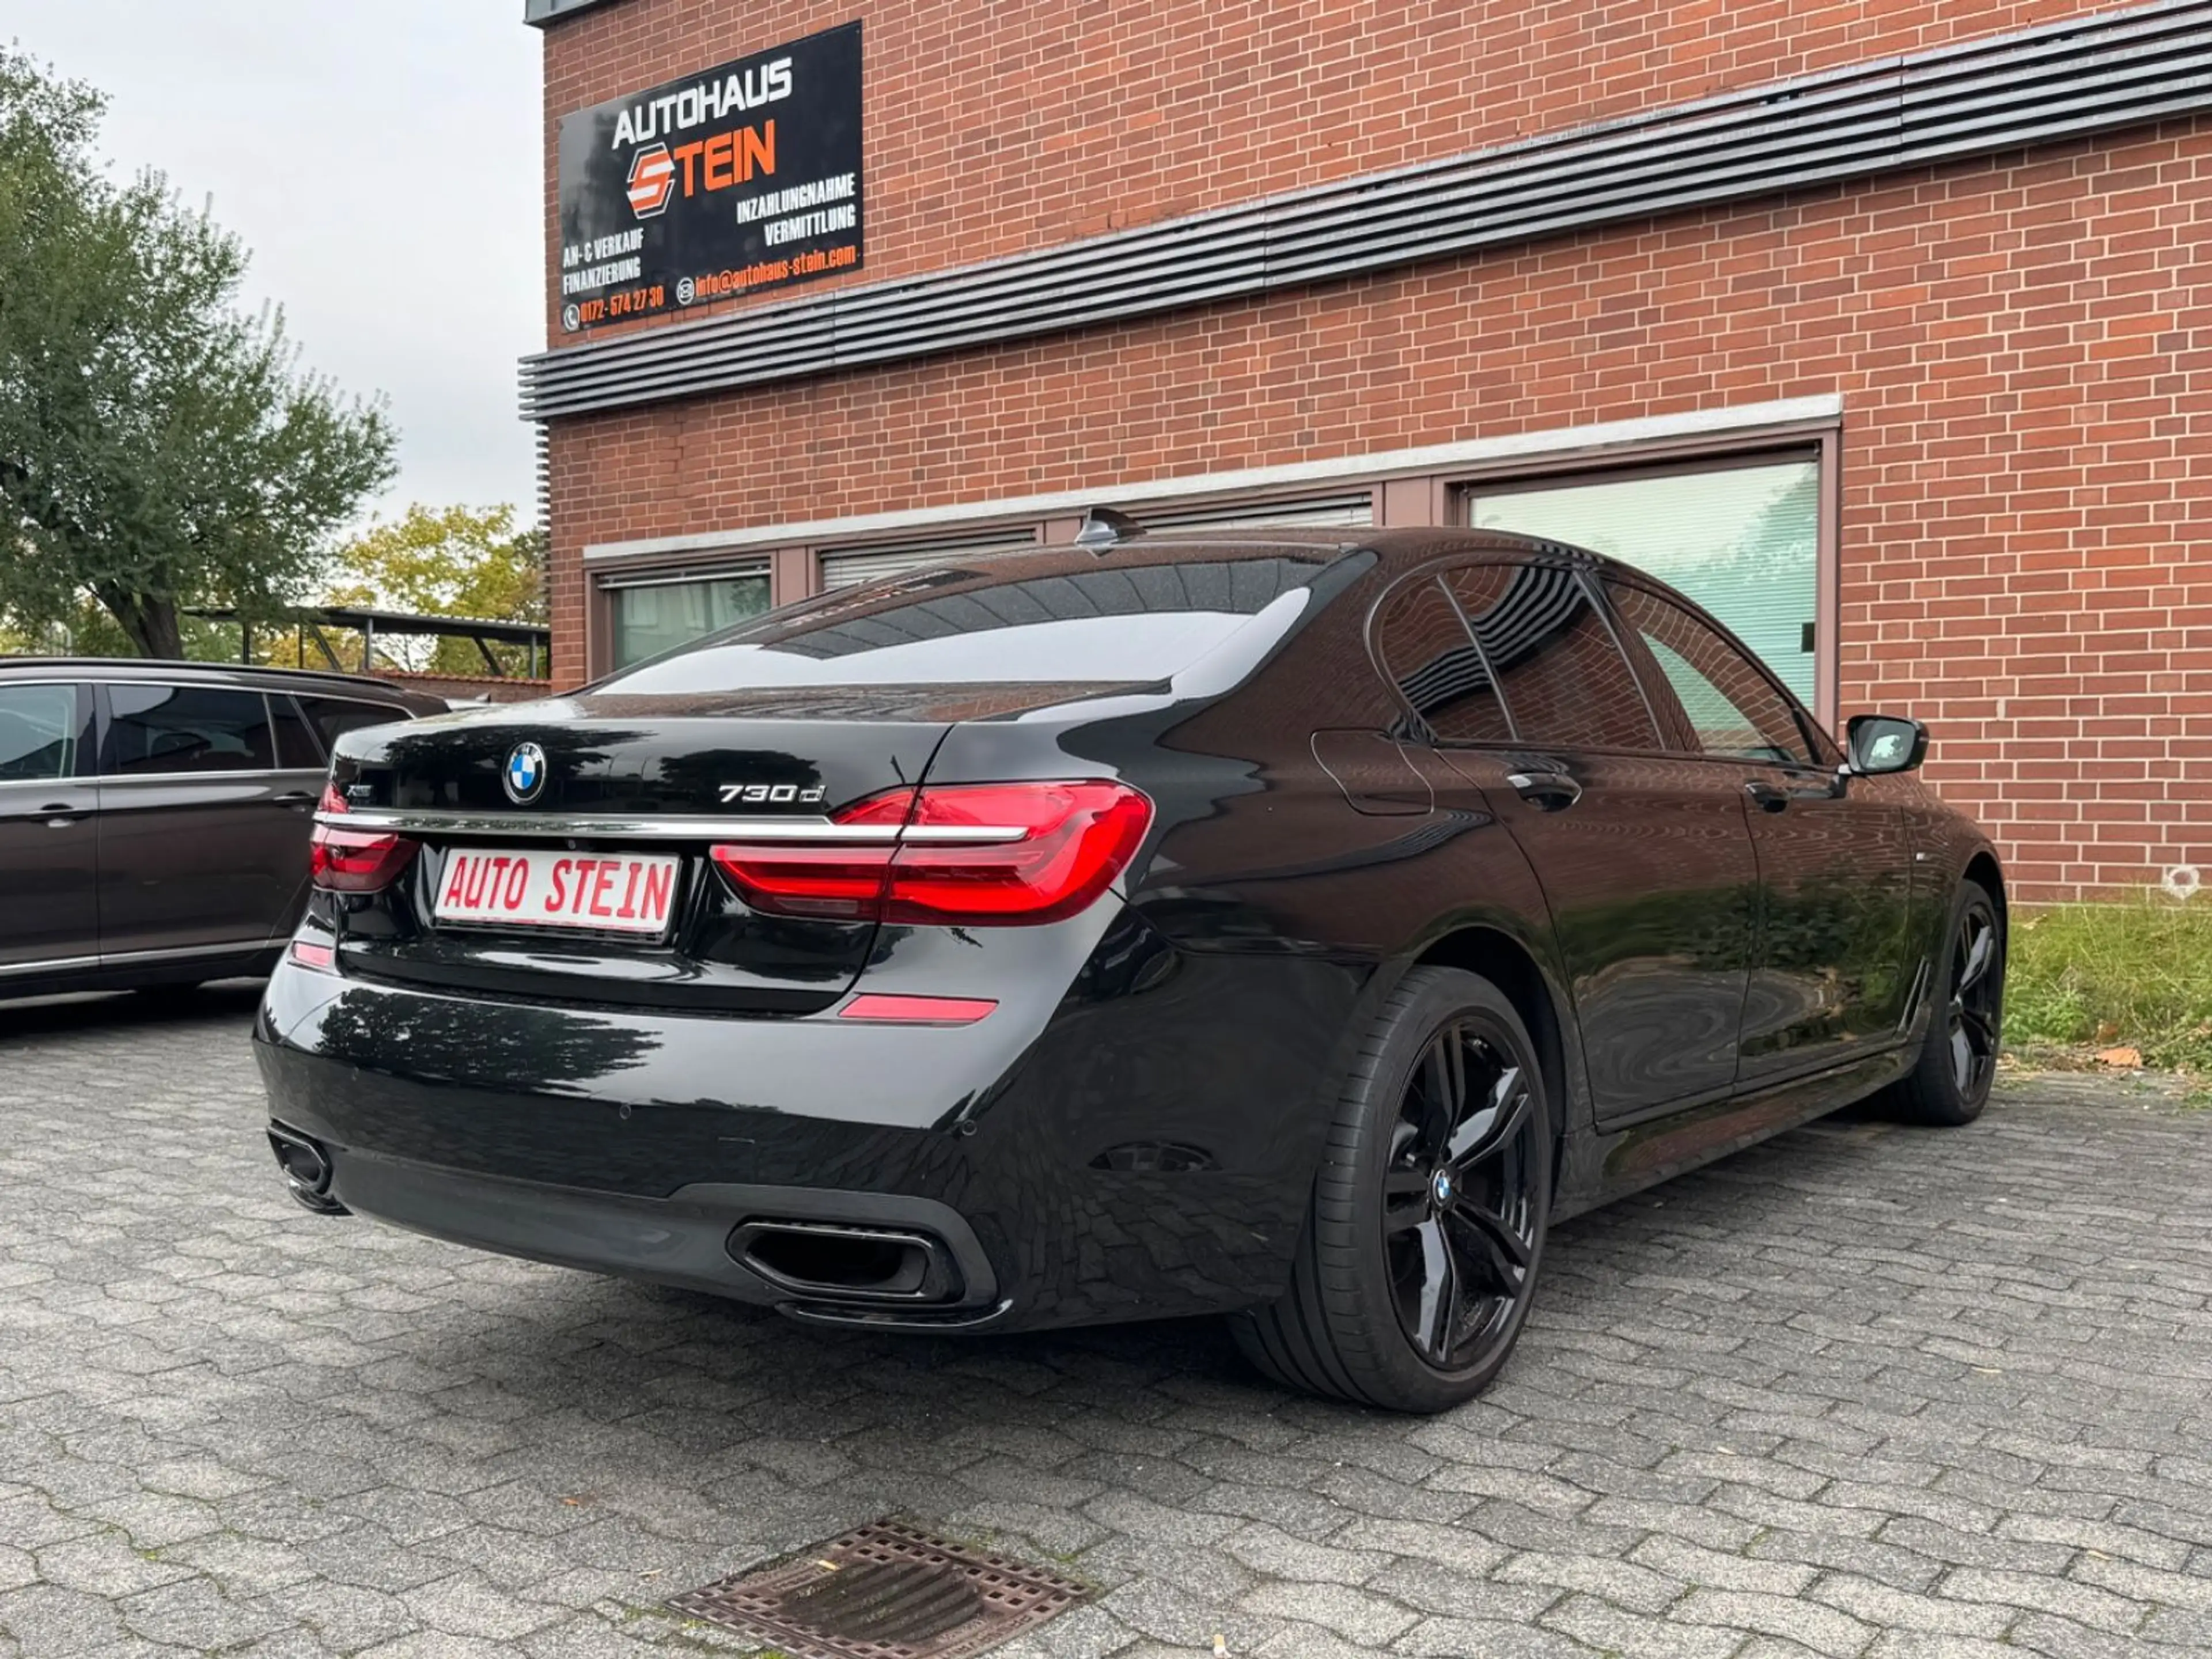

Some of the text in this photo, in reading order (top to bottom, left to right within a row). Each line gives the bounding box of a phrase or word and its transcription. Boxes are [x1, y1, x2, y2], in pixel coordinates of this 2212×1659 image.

[612, 57, 792, 150] AUTOHAUS
[627, 119, 775, 219] STEIN
[737, 173, 855, 224] INZAHLUNGNAHME
[594, 228, 643, 259] VERKAUF
[764, 204, 856, 247] VERMITTLUNG
[563, 256, 641, 295] FINANZIERUNG
[695, 245, 856, 297] info@autohaus-stein.com
[610, 293, 631, 316] 574
[634, 289, 647, 310] 27
[649, 285, 664, 307] 30
[719, 785, 826, 802] 730d
[445, 856, 672, 921] AUTO STEIN
